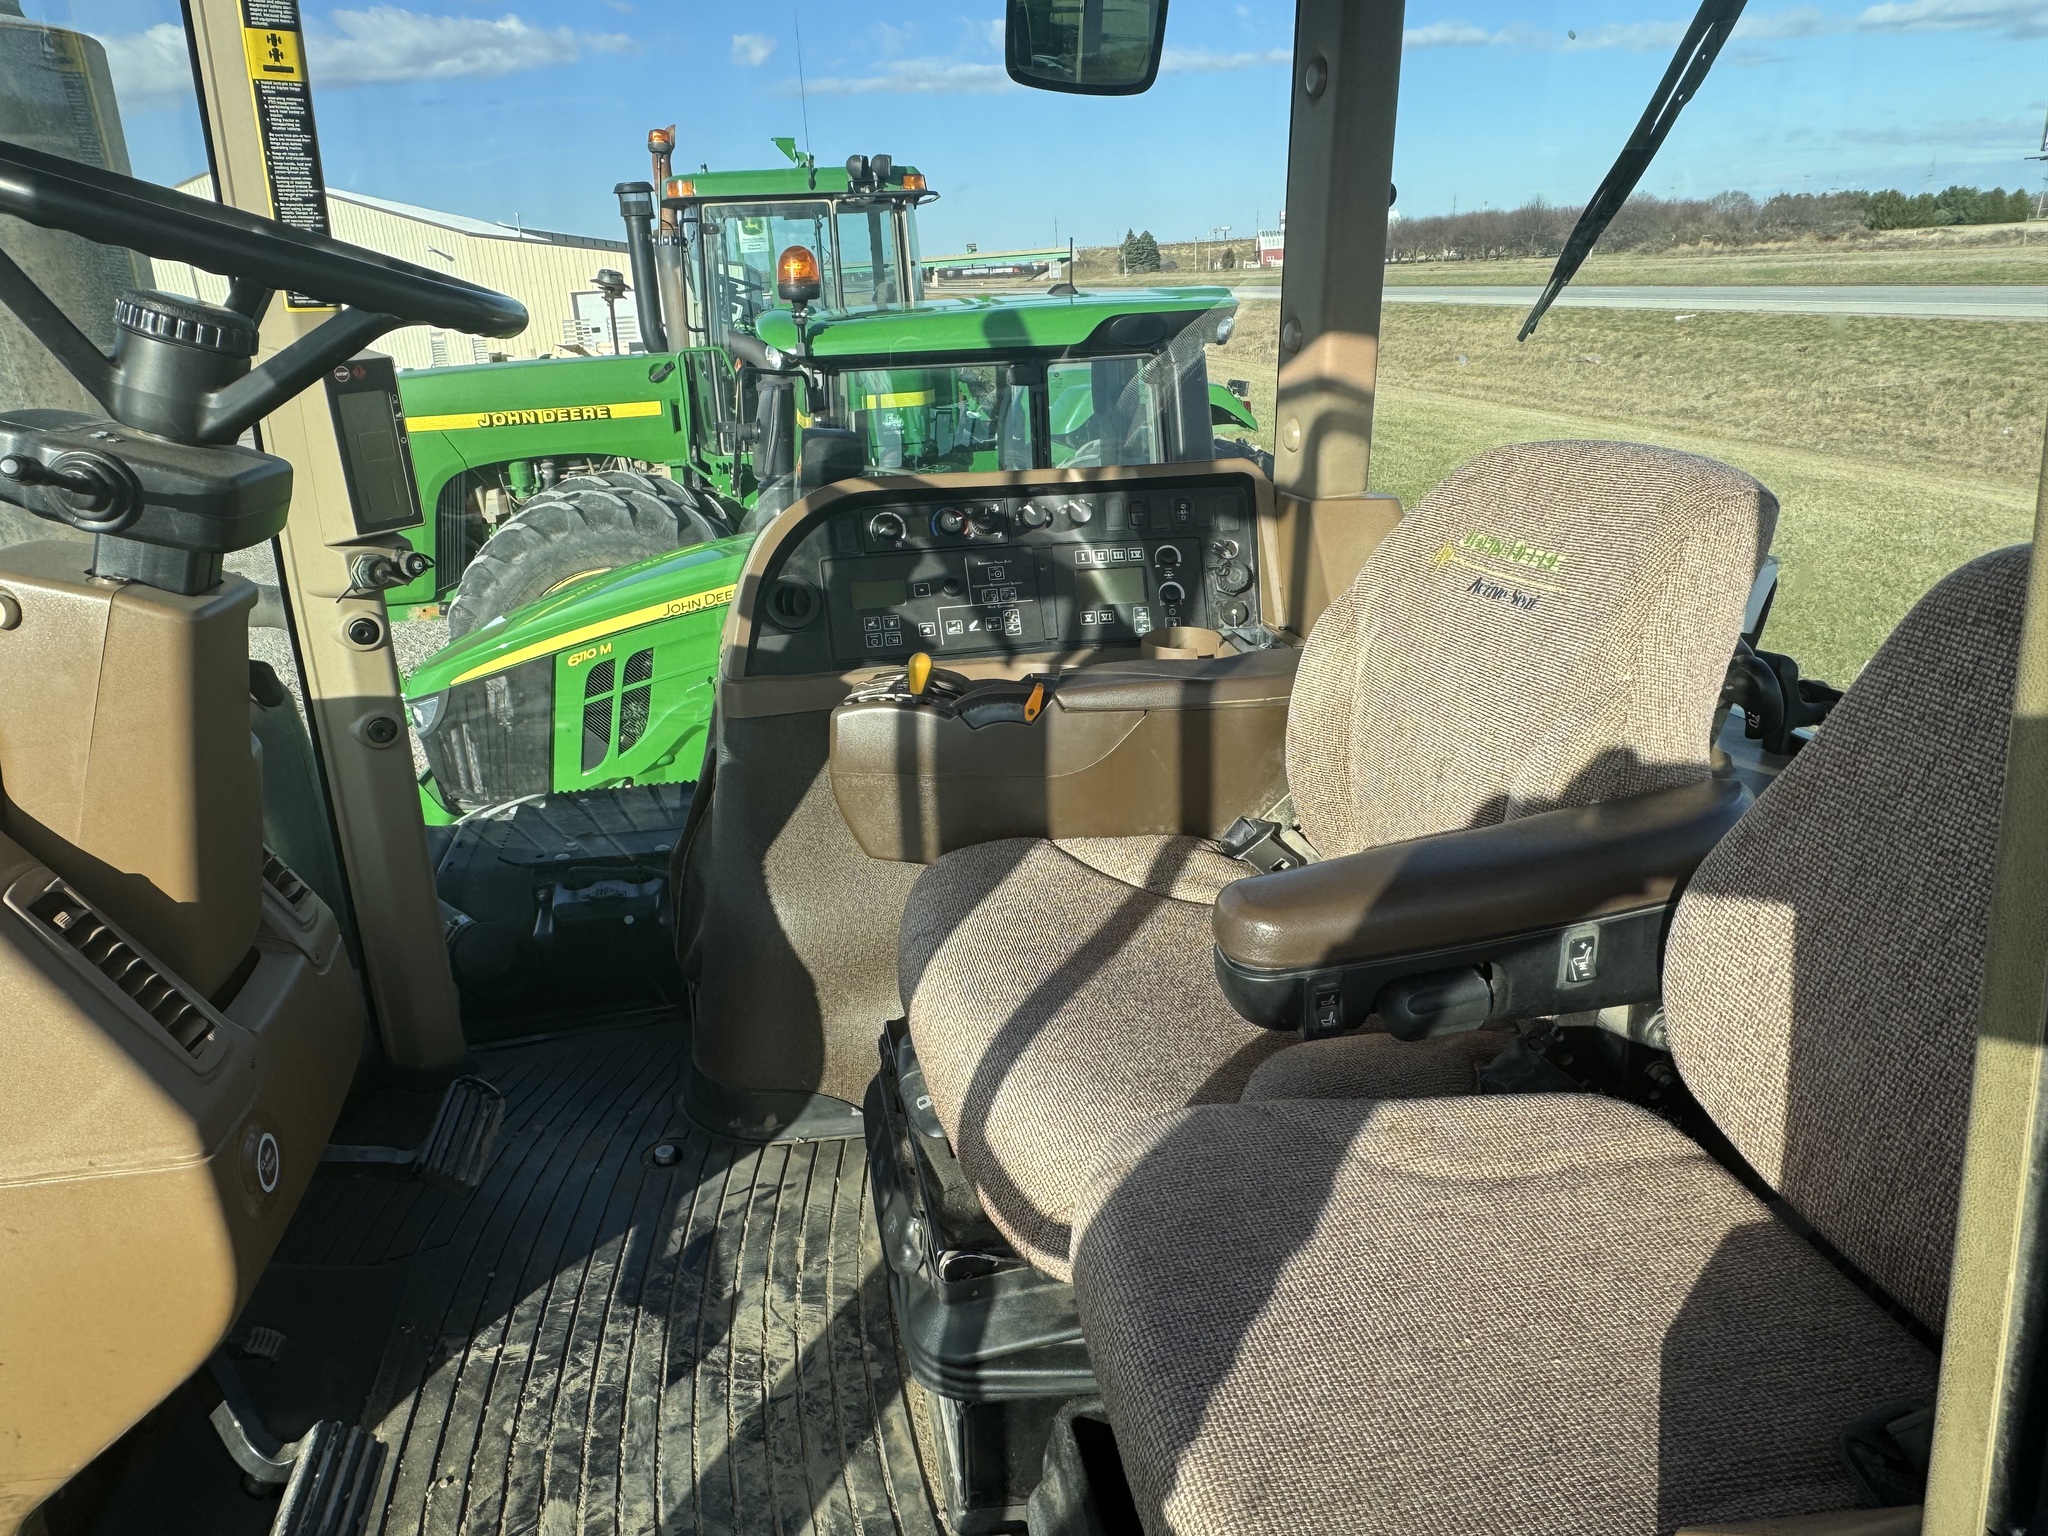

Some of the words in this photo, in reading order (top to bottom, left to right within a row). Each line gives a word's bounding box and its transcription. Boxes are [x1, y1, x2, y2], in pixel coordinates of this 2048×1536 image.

[478, 411, 539, 427] JOHN
[541, 405, 613, 423] DEERE
[663, 598, 701, 616] JOHN
[705, 589, 735, 606] DEE
[567, 647, 597, 667] 6110
[600, 642, 612, 655] M
